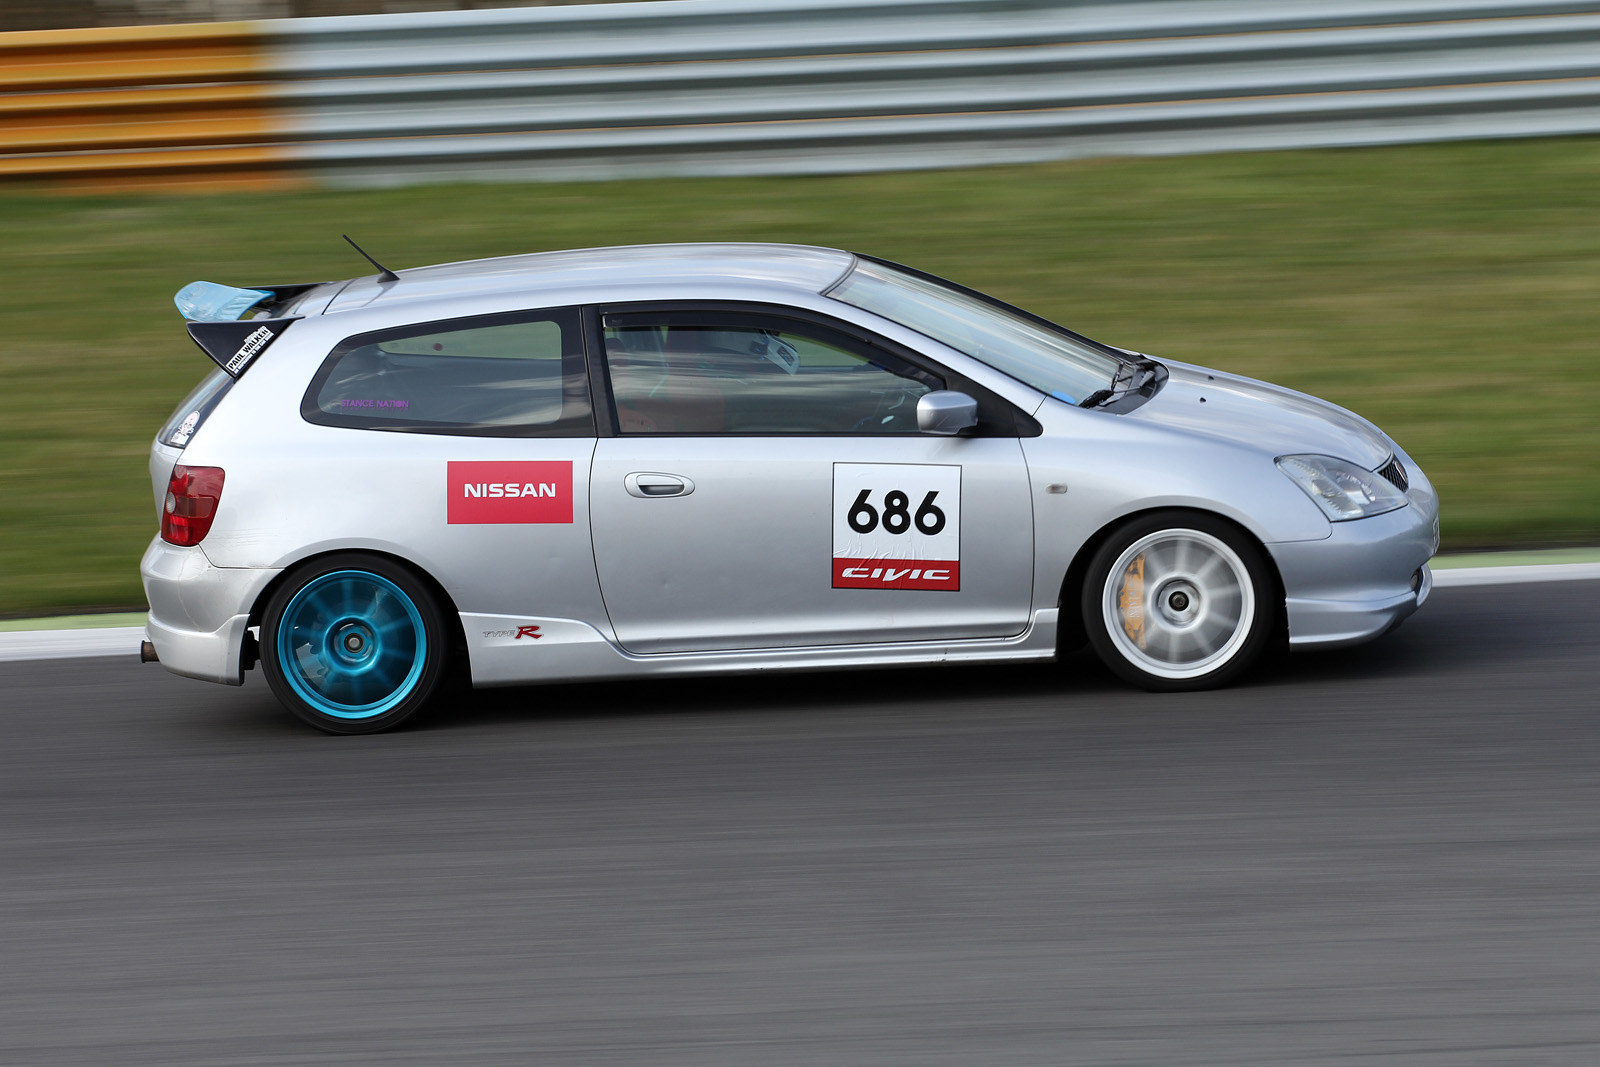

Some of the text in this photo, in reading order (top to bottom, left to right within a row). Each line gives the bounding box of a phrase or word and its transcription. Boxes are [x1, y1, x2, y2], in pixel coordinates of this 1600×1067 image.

[228, 354, 245, 370] PAUL
[242, 329, 269, 354] WALKER
[376, 400, 409, 408] NATION
[464, 483, 556, 498] NISSAN
[847, 489, 946, 536] 686
[841, 567, 951, 581] CIVIC
[483, 625, 544, 640] TYPE R
